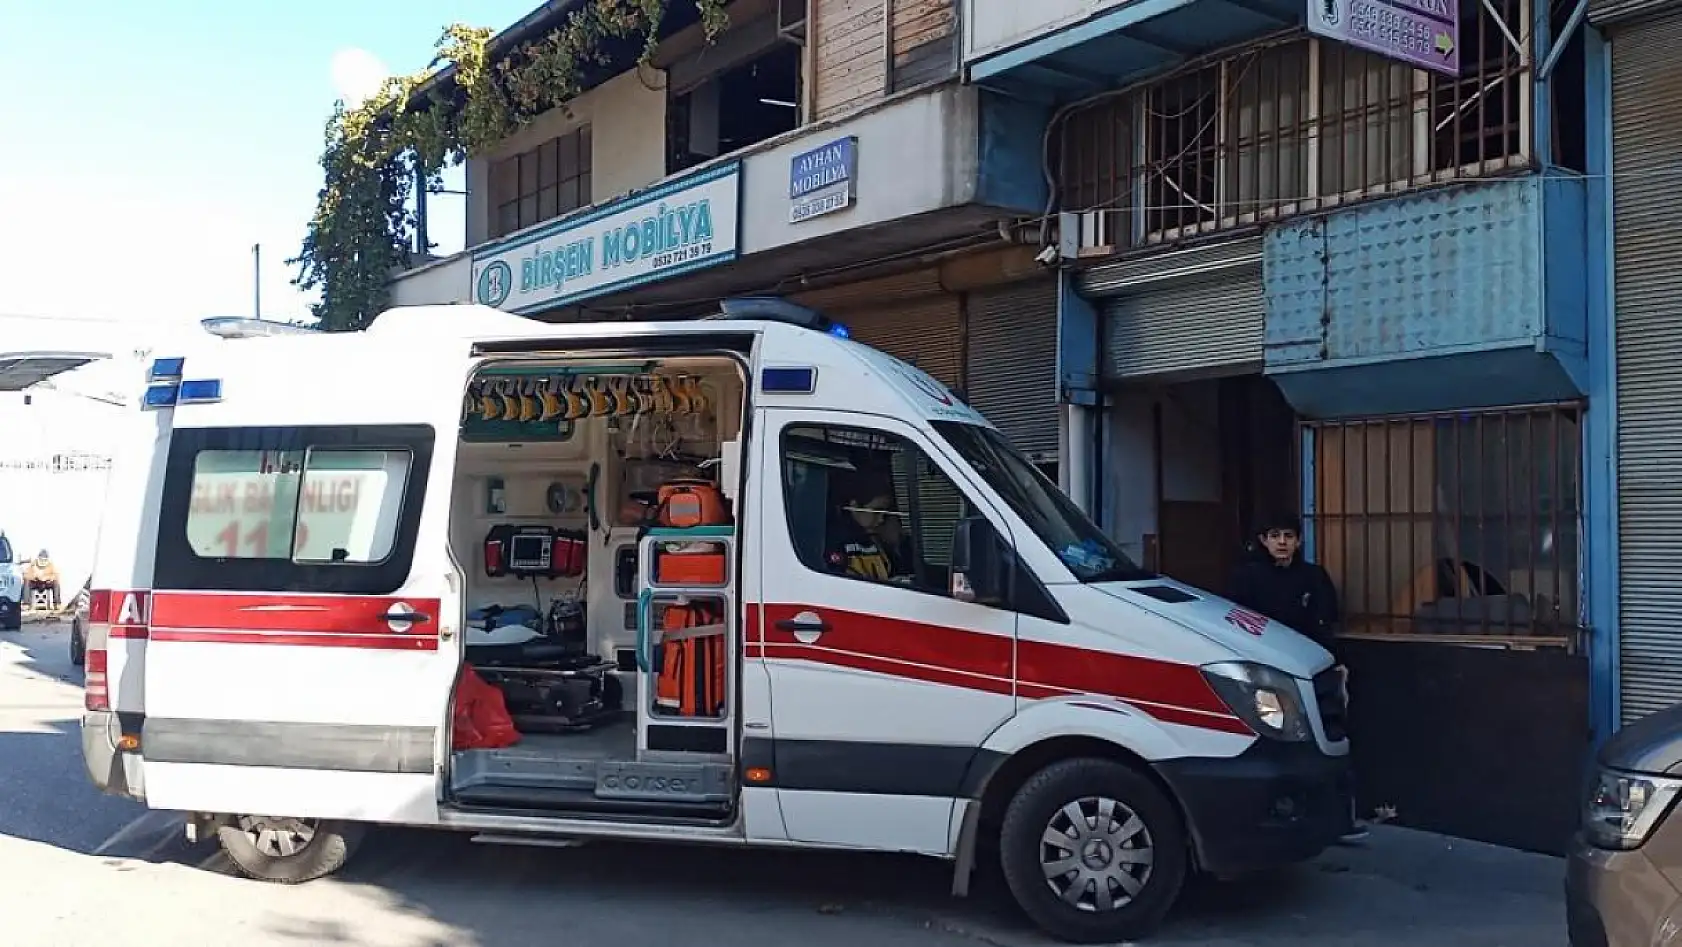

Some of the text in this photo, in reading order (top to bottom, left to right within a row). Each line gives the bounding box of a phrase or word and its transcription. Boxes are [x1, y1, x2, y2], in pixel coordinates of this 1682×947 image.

[800, 144, 842, 174] AYHAN
[793, 163, 847, 195] MOBİLYA
[520, 199, 713, 292] BİRŞEN MOBİLYA
[652, 254, 672, 268] 0532
[674, 248, 688, 262] 721
[118, 592, 151, 624] A
